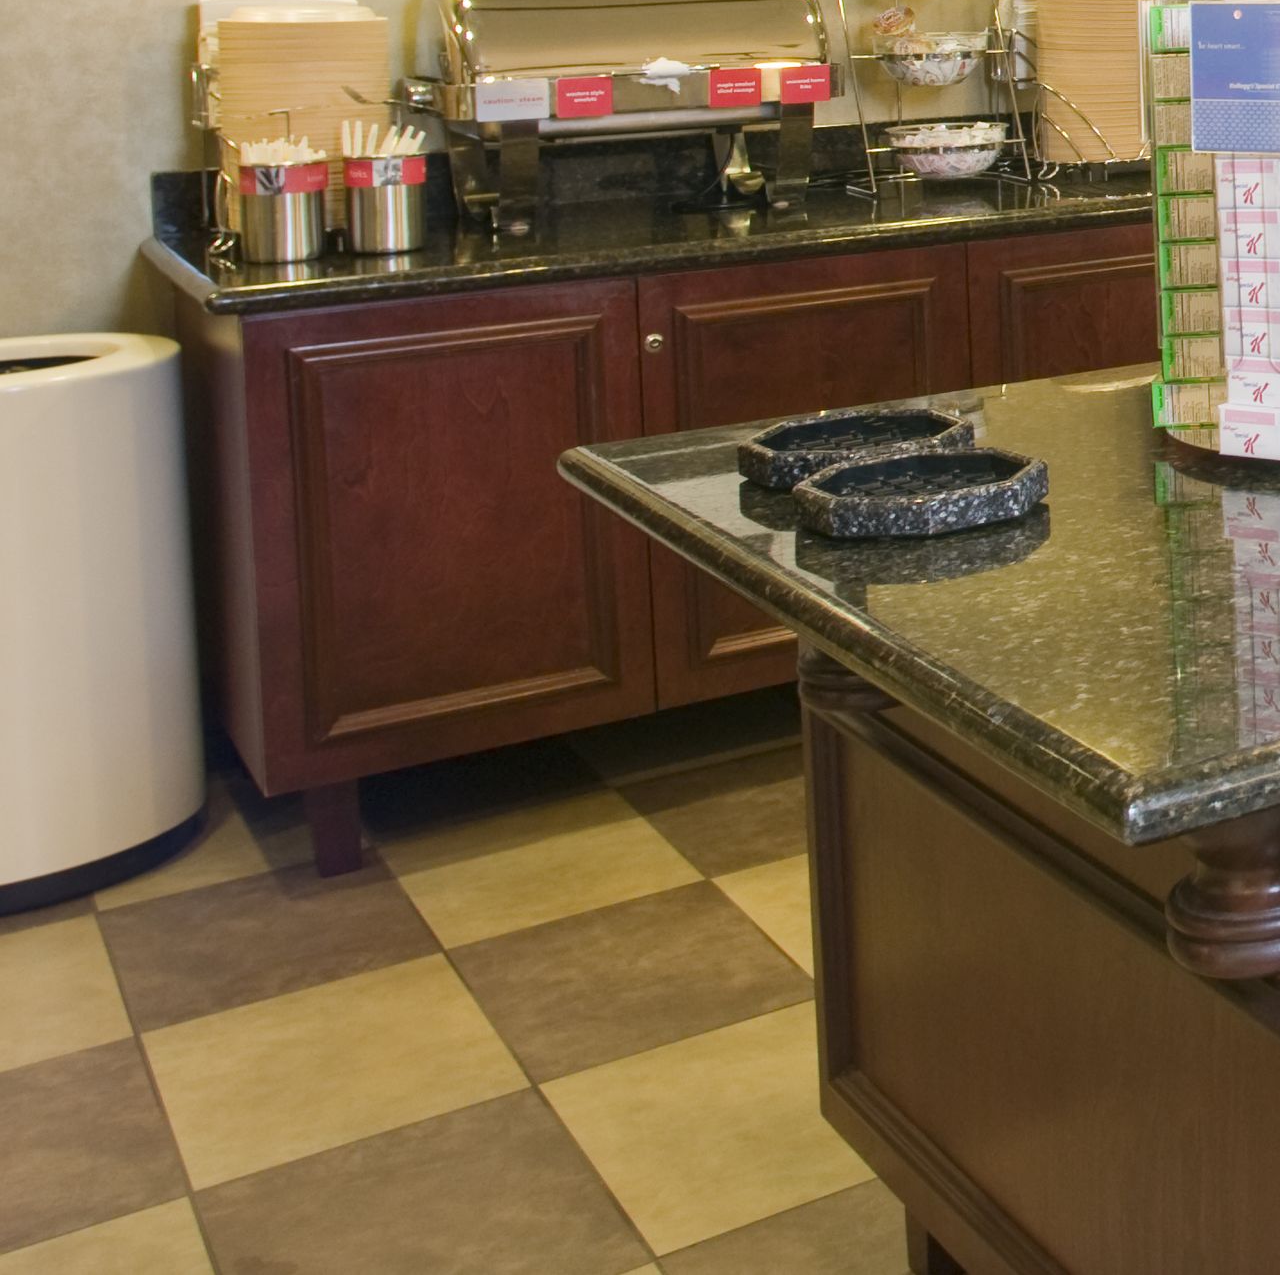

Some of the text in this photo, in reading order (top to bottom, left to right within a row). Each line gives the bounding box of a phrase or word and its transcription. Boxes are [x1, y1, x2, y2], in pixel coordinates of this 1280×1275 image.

[1243, 182, 1260, 205] K
[1246, 232, 1263, 255] K
[1248, 281, 1265, 304] K
[1250, 332, 1267, 355] K
[1252, 382, 1269, 404] K
[1243, 433, 1260, 455] K
